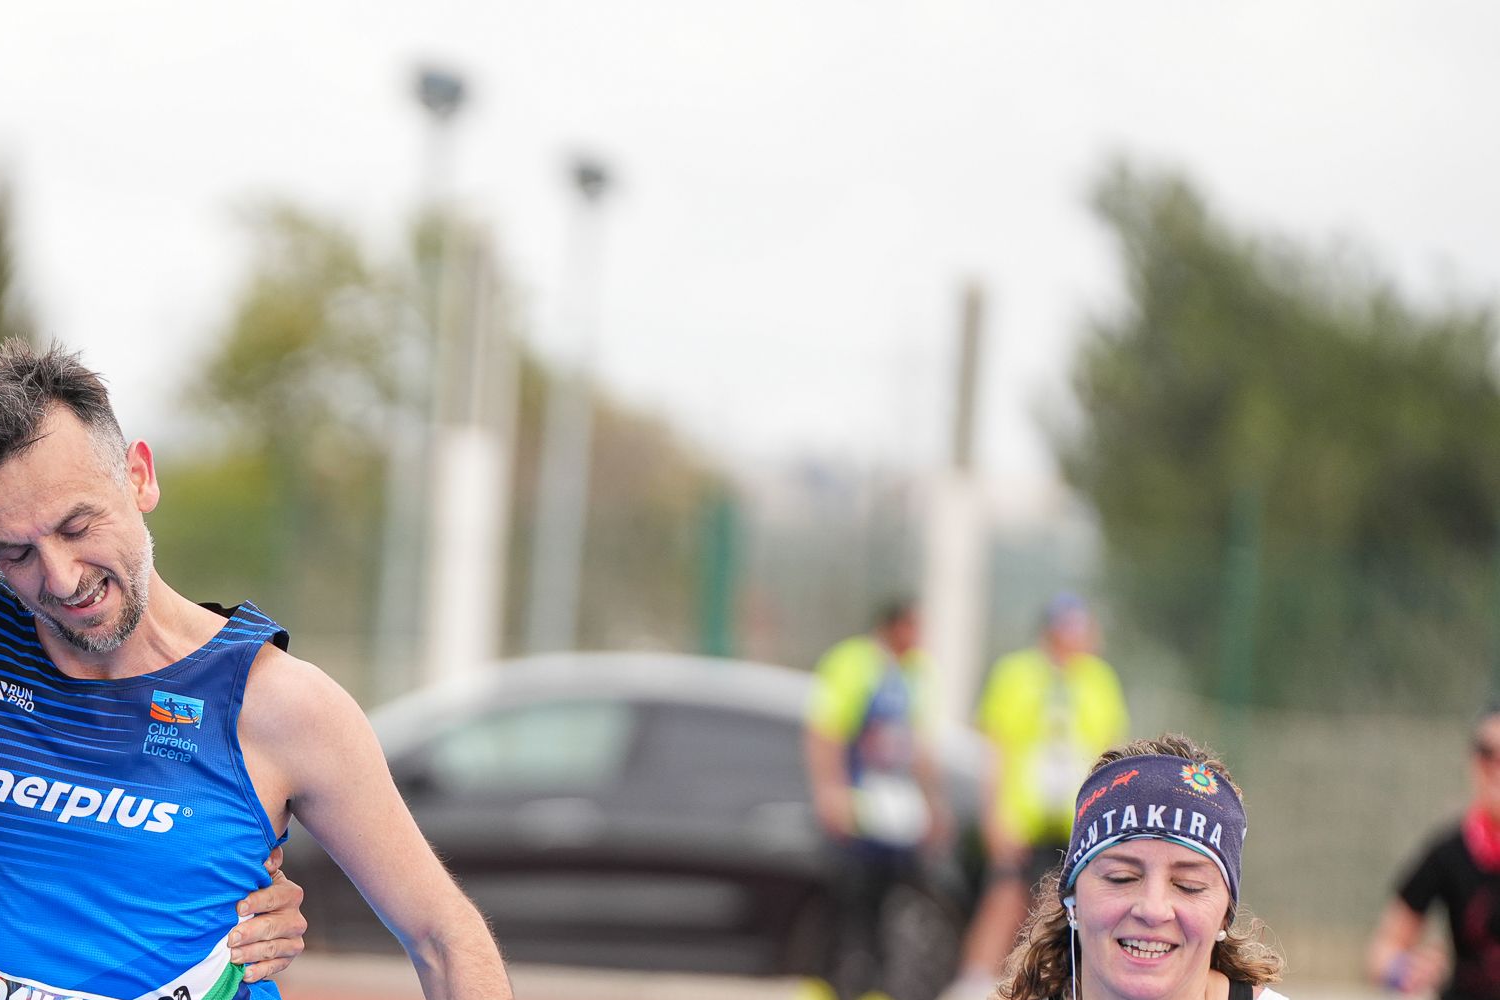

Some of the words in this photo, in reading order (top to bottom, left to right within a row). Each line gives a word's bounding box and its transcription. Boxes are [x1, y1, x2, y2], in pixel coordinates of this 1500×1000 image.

[8, 683, 33, 700] RUN
[8, 693, 35, 712] PRO
[148, 723, 178, 737] Club
[143, 741, 192, 763] Lucena
